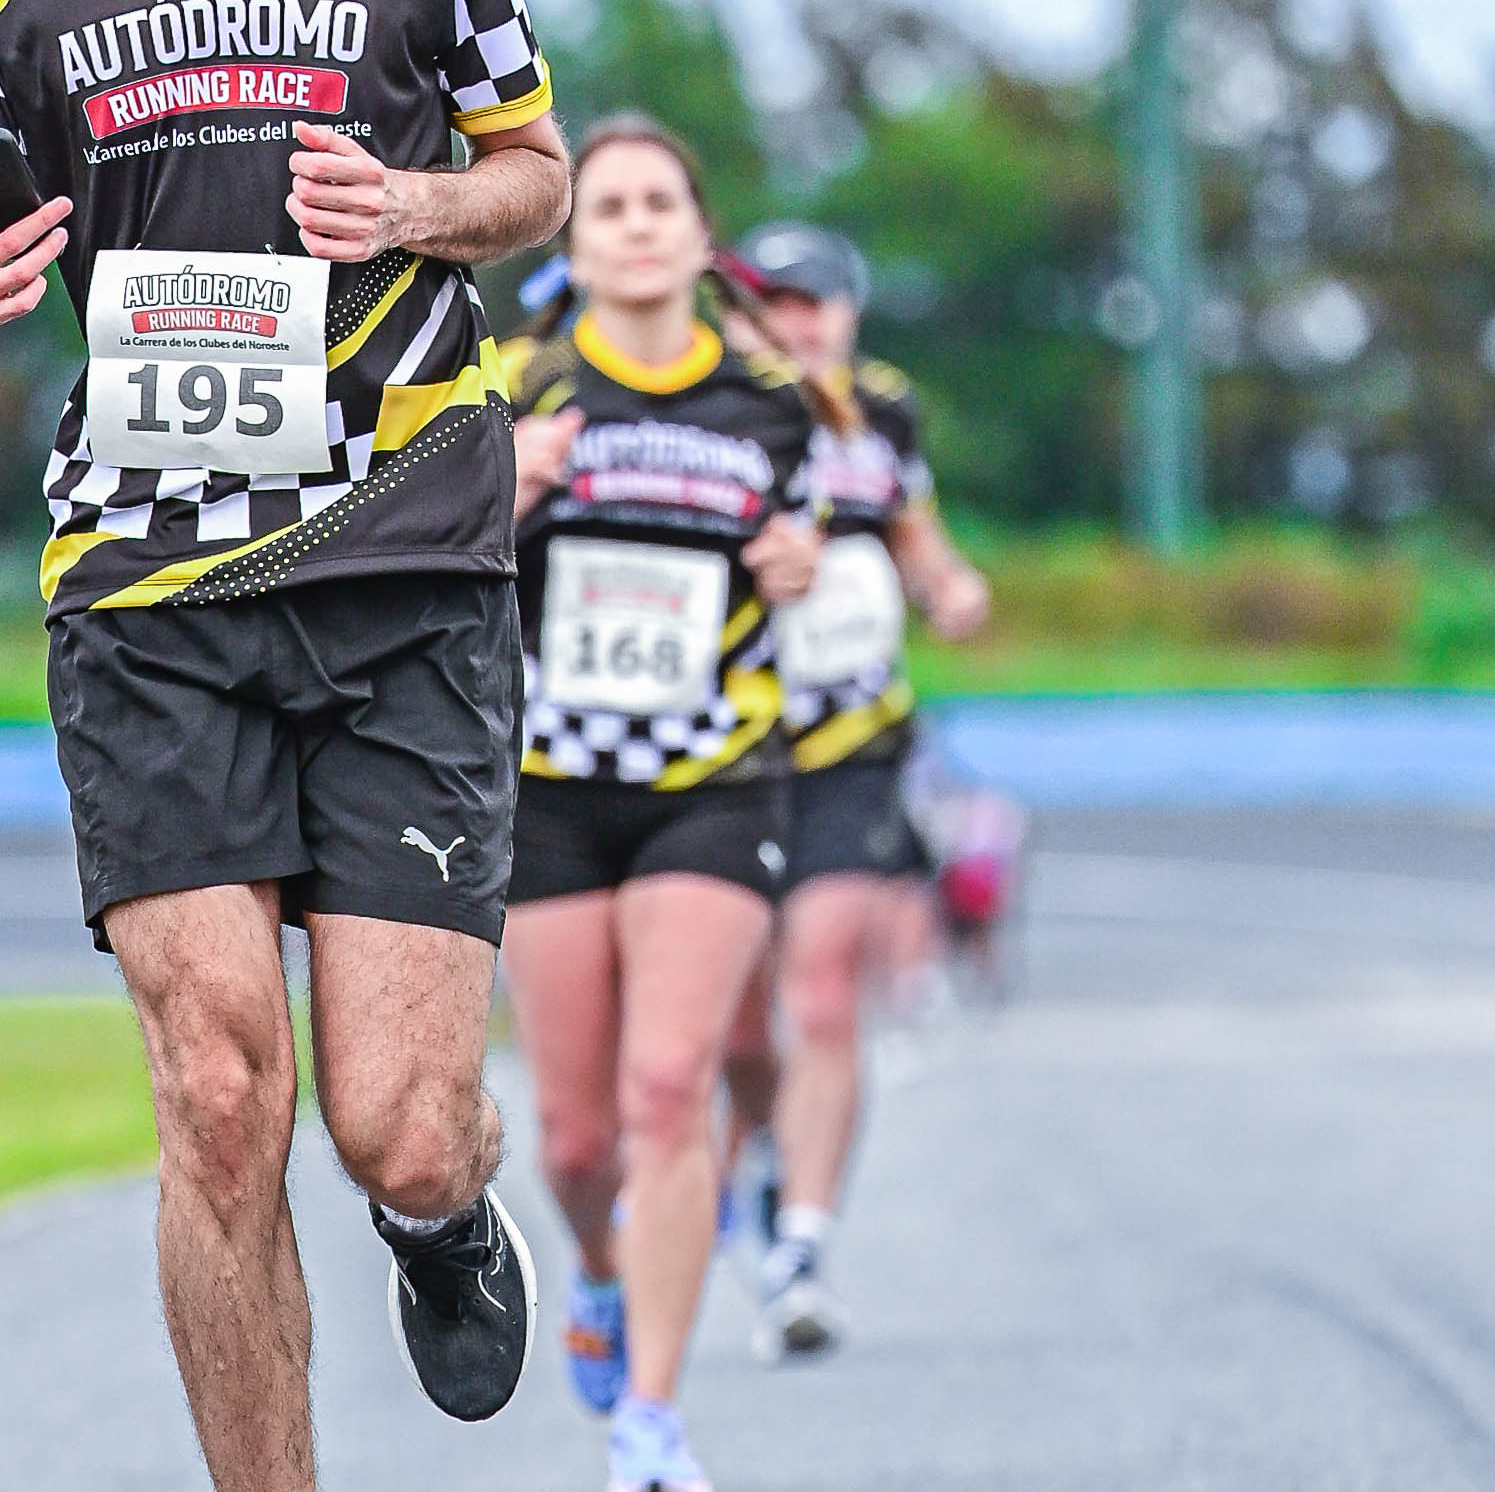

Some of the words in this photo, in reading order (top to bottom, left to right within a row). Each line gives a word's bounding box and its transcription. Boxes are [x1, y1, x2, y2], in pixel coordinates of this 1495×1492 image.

[107, 70, 230, 128] RUNNING
[239, 69, 313, 107] RACE
[172, 128, 195, 147] los
[198, 124, 256, 146] Clubes
[259, 120, 287, 141] del
[123, 264, 291, 313] AUTÓDROMO
[148, 310, 217, 330] RUNNING
[220, 311, 261, 333] RACE
[120, 336, 131, 346] La
[132, 337, 167, 347] Carrera
[169, 337, 181, 347] de
[183, 337, 197, 348] los
[199, 338, 231, 349] Clubes
[232, 339, 247, 349] del
[249, 340, 290, 352] Noroeste
[127, 363, 284, 437] 195
